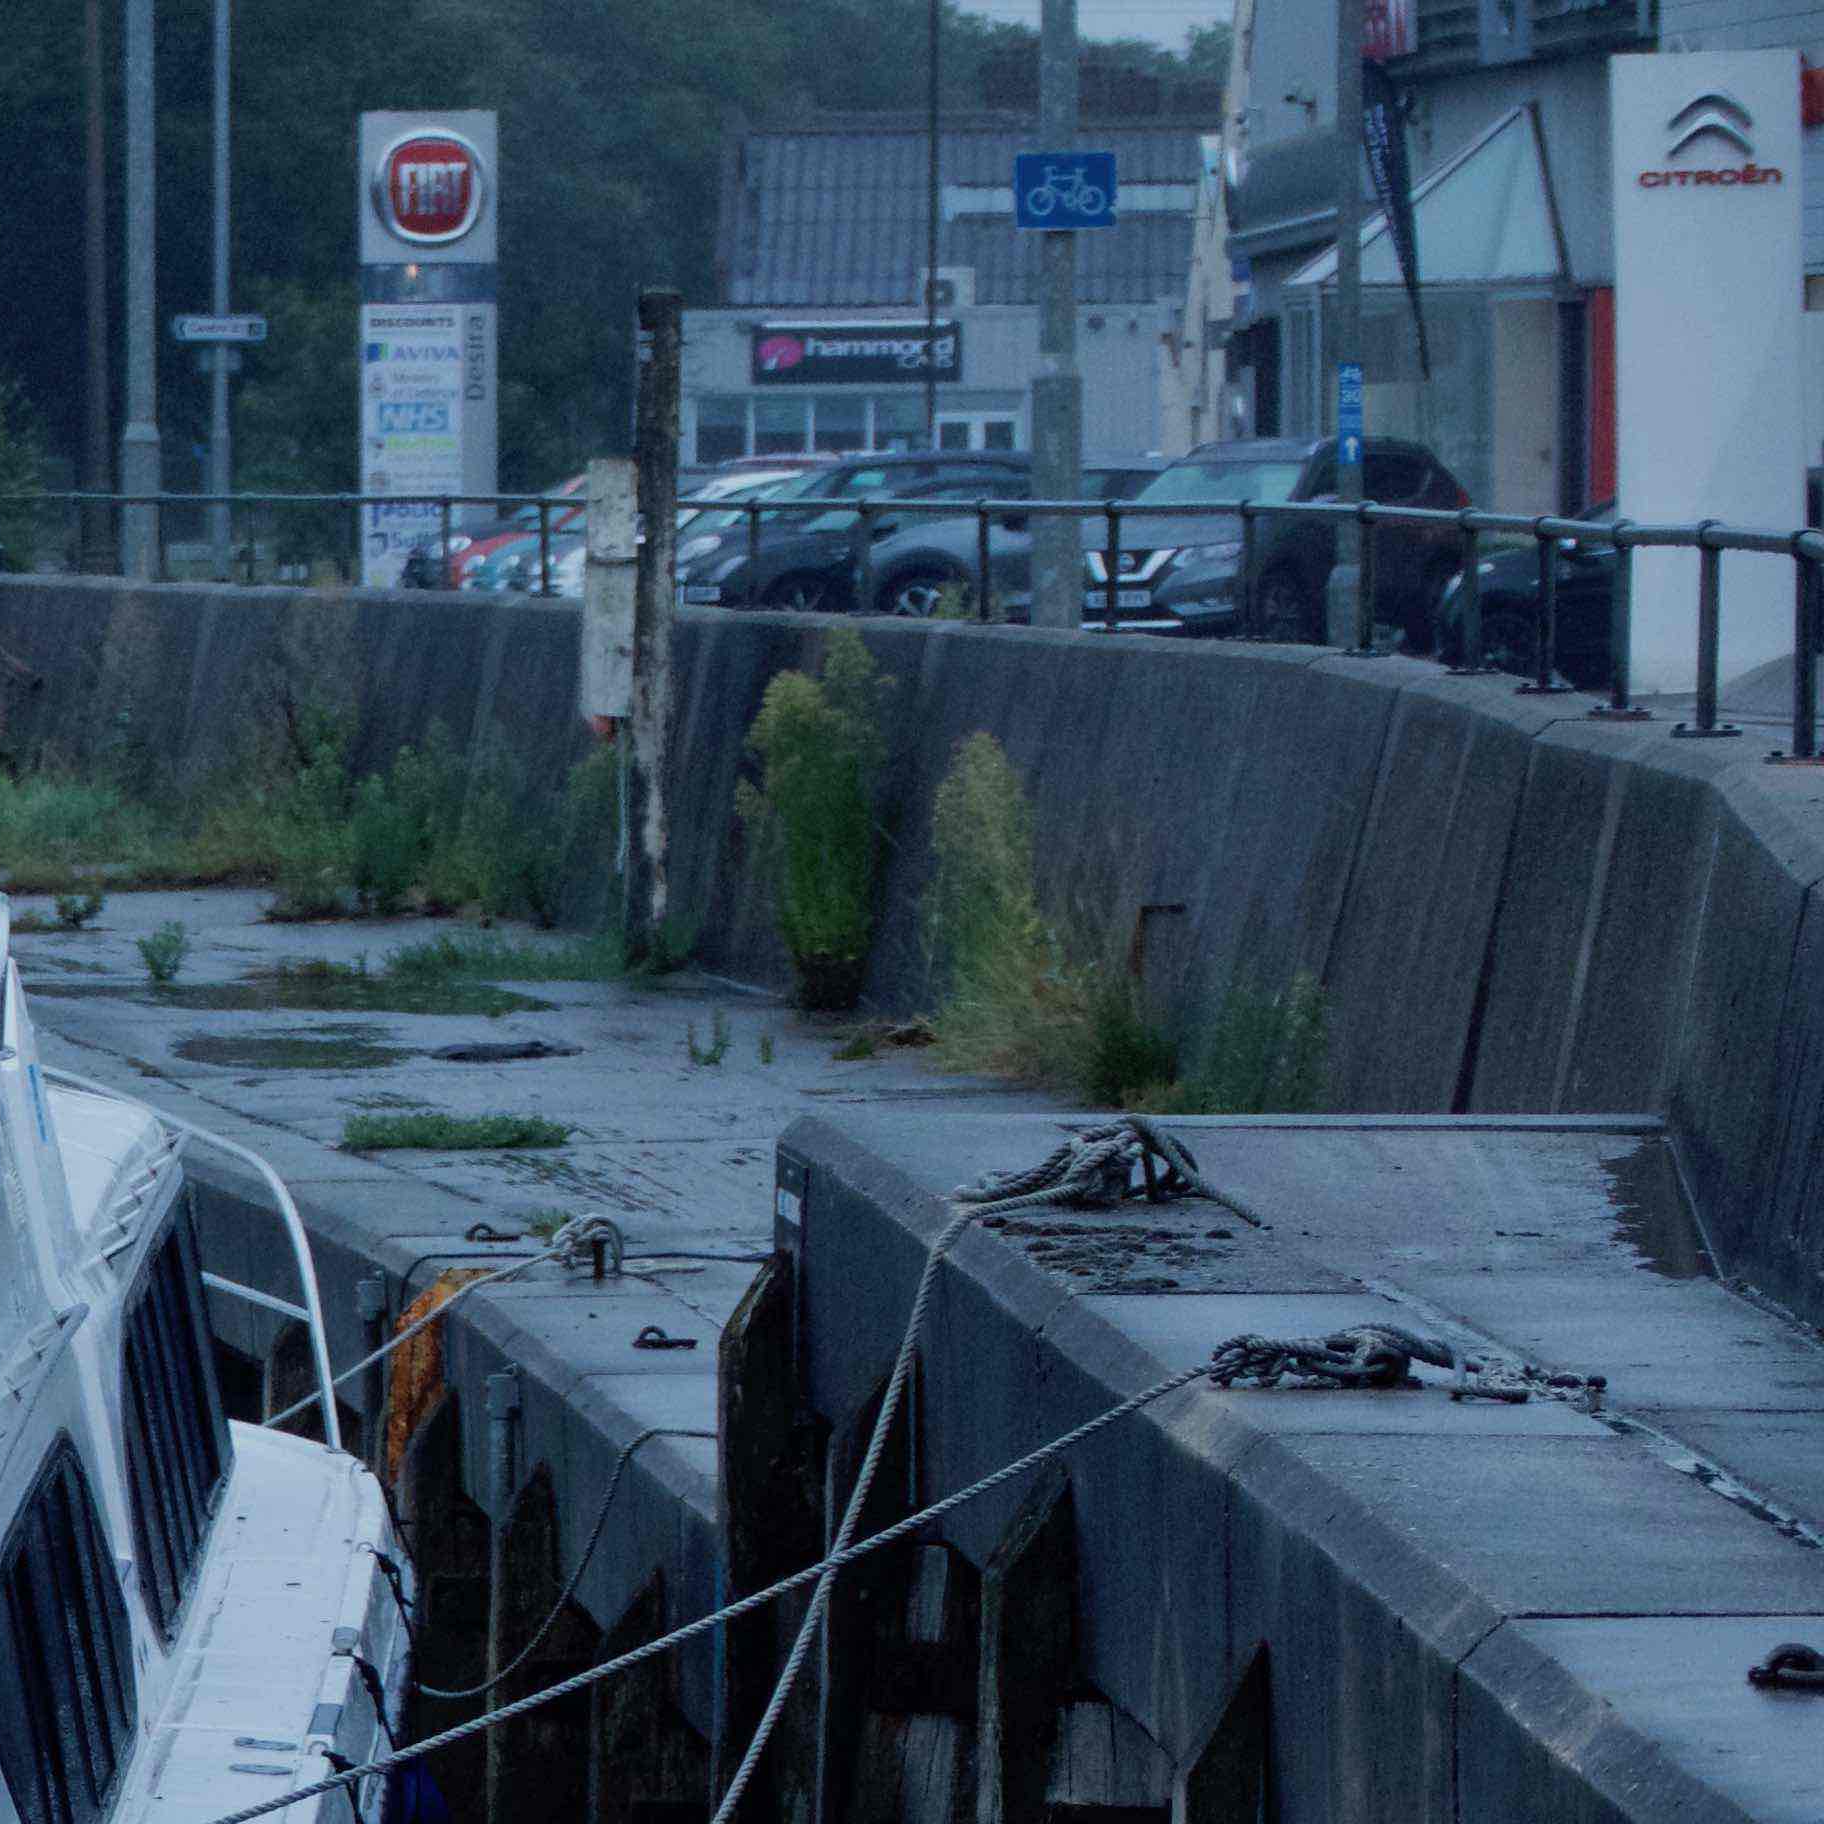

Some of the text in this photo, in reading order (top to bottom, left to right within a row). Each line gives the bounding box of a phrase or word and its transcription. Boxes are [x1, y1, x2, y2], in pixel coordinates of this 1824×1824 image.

[399, 161, 468, 215] FIAT
[369, 318, 457, 329] DISCOUNTS
[392, 344, 459, 361] AVIVA
[383, 404, 448, 431] NHS
